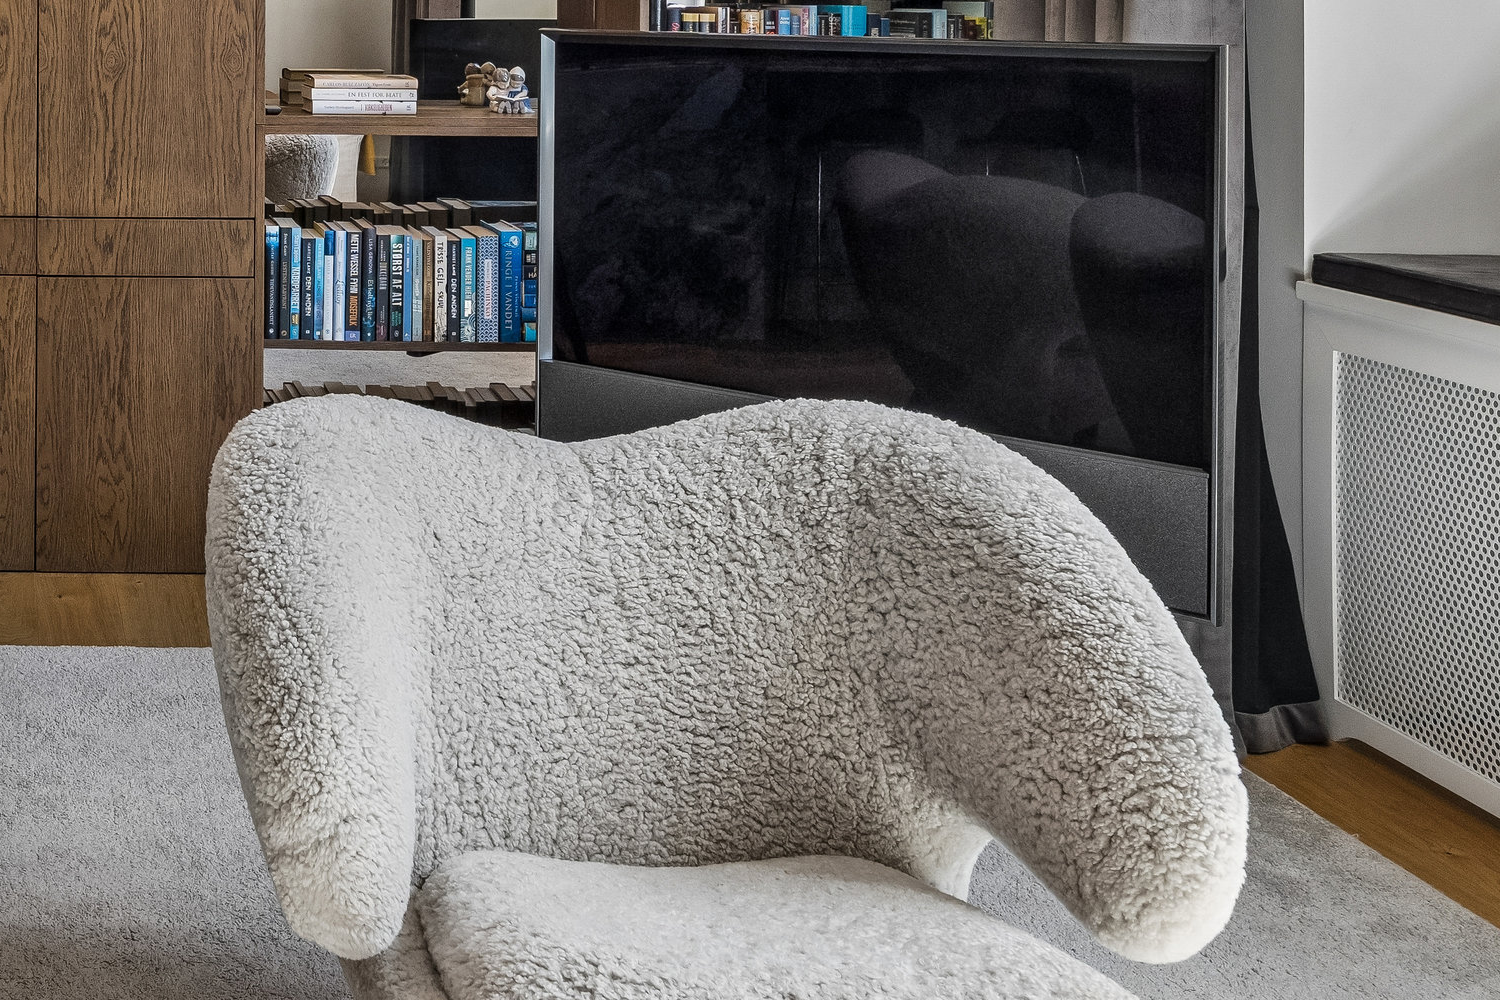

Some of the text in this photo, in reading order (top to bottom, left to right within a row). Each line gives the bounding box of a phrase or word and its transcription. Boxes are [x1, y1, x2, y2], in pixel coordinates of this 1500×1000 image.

[350, 233, 359, 253] METTE
[350, 253, 359, 277] WESSEL
[392, 243, 403, 307] STØRST AF ALT
[504, 250, 512, 281] RINGE
[349, 295, 358, 326] MOSEFOLK
[504, 291, 513, 331] VANDET
